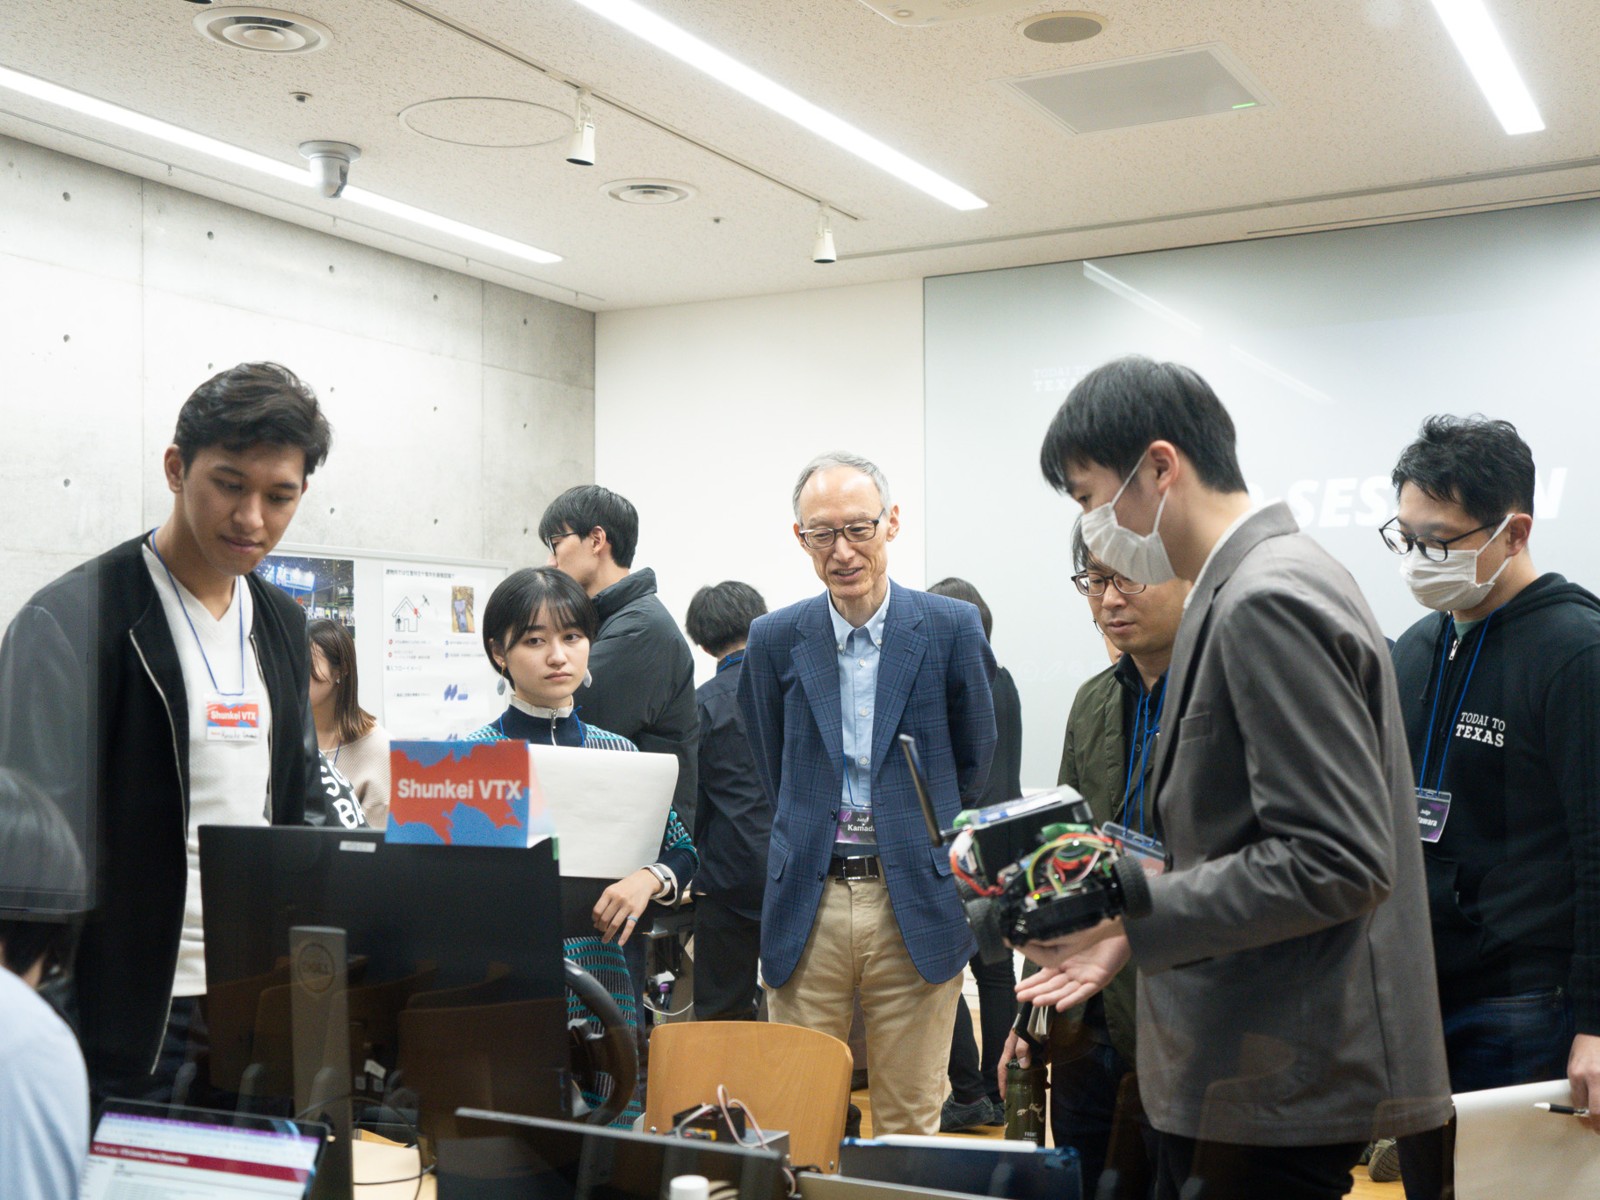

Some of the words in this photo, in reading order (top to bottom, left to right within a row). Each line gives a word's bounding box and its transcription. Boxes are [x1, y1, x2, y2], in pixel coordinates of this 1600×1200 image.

[1287, 467, 1568, 528] SESN
[210, 710, 240, 720] Shunkei
[241, 711, 257, 721] VTX
[1460, 711, 1490, 726] TODAI
[1491, 717, 1506, 732] TO
[1455, 724, 1505, 748] TEXAS
[397, 778, 474, 799] Shunkei
[478, 779, 522, 801] VTX
